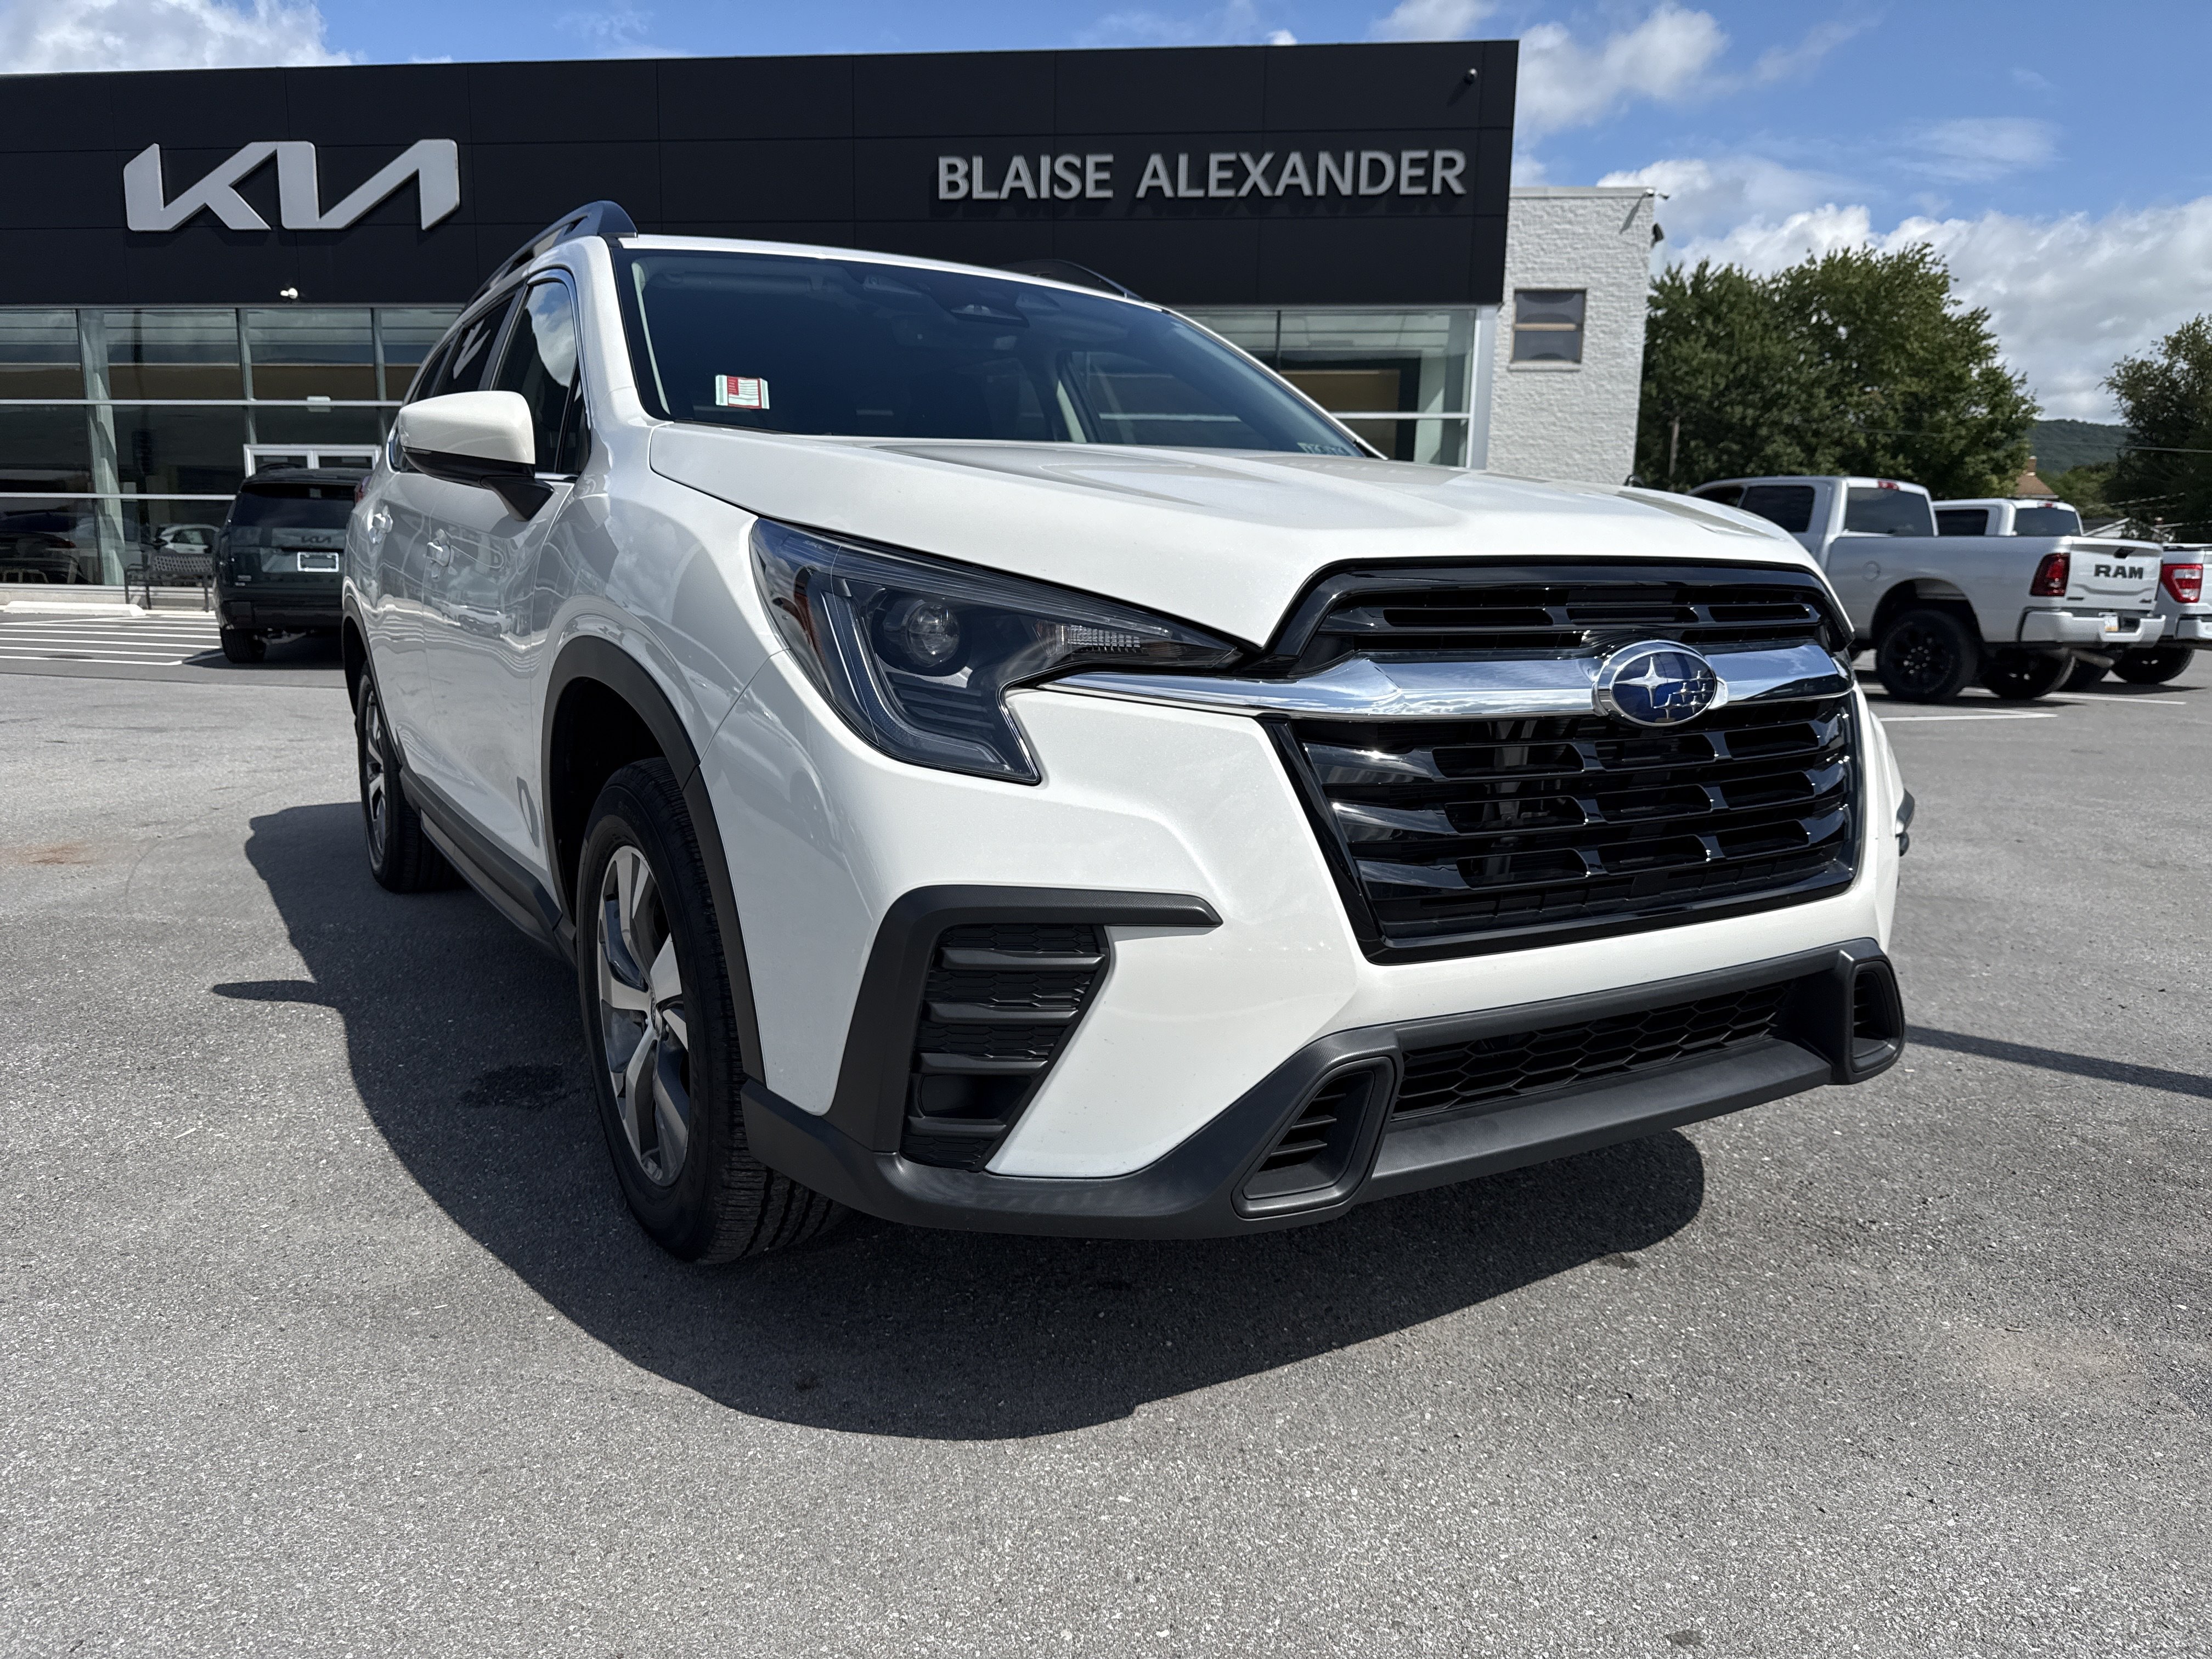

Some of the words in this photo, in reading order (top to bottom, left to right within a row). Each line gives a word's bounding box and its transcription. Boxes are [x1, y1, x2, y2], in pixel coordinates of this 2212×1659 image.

[123, 138, 460, 232] KIA
[938, 154, 1114, 199] BLAISE
[1135, 149, 1467, 198] ALEXANDER
[2094, 564, 2143, 579] RAM
